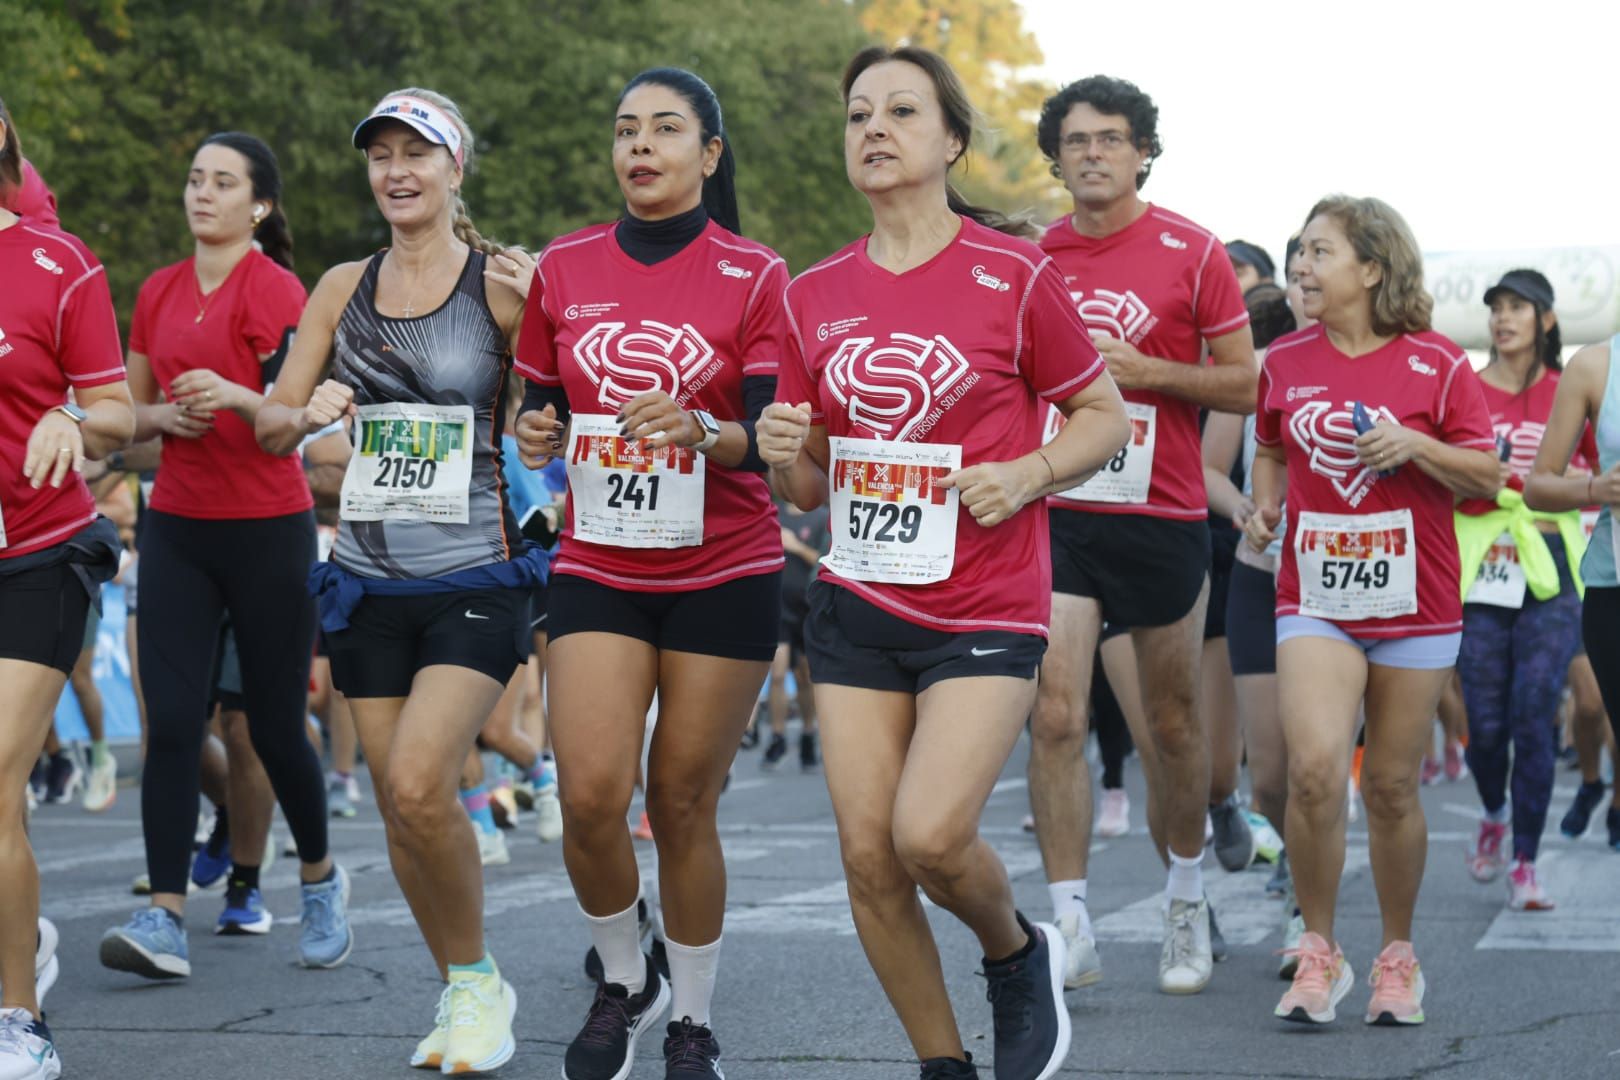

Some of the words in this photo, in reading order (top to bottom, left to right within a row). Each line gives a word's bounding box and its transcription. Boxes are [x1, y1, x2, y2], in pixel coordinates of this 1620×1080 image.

[688, 358, 725, 394] SOLIDARIA
[909, 407, 945, 443] PERSONA
[940, 371, 981, 410] SOLIDARIA
[373, 456, 437, 490] 2150
[867, 481, 895, 492] VALENCIA
[607, 473, 660, 511] 241
[849, 500, 923, 543] 5729
[1321, 560, 1390, 590] 5749
